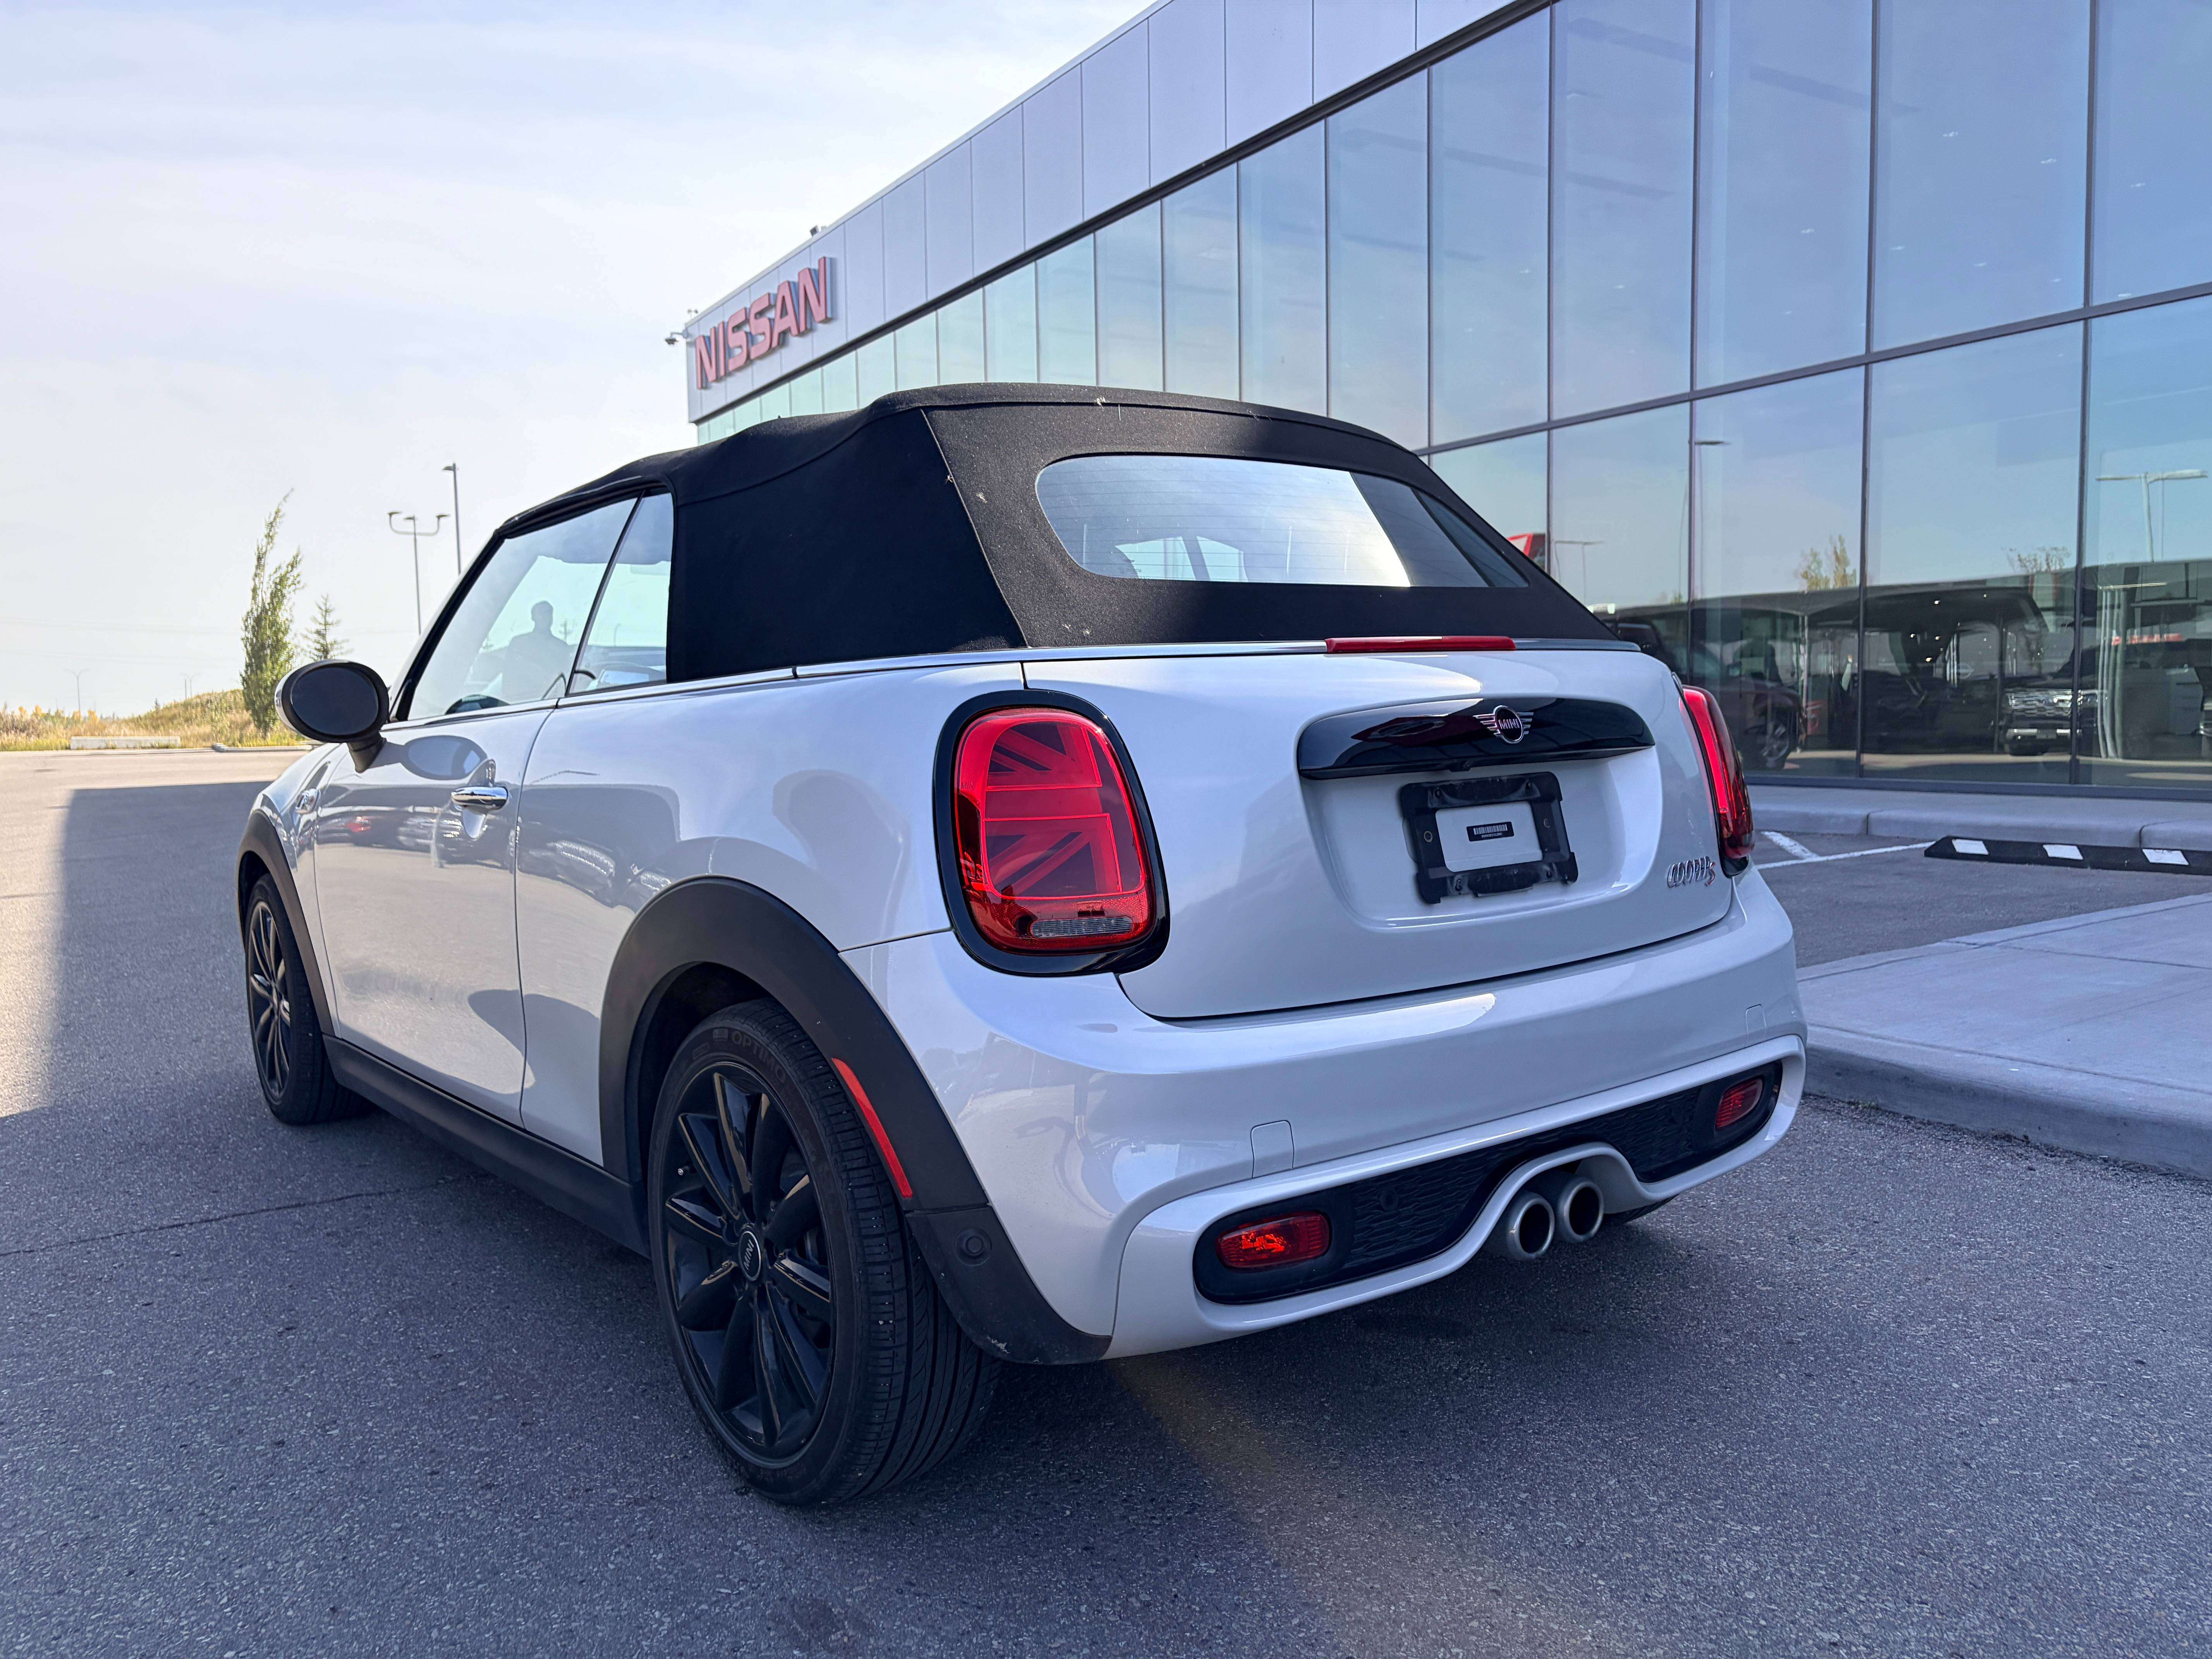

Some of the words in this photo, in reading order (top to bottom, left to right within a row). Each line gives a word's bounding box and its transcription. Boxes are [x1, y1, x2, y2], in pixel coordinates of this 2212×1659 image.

[695, 256, 829, 389] NISSAN
[1498, 718, 1520, 729] MINI
[732, 1031, 786, 1083] OPTIMO
[743, 1239, 755, 1270] MINI
